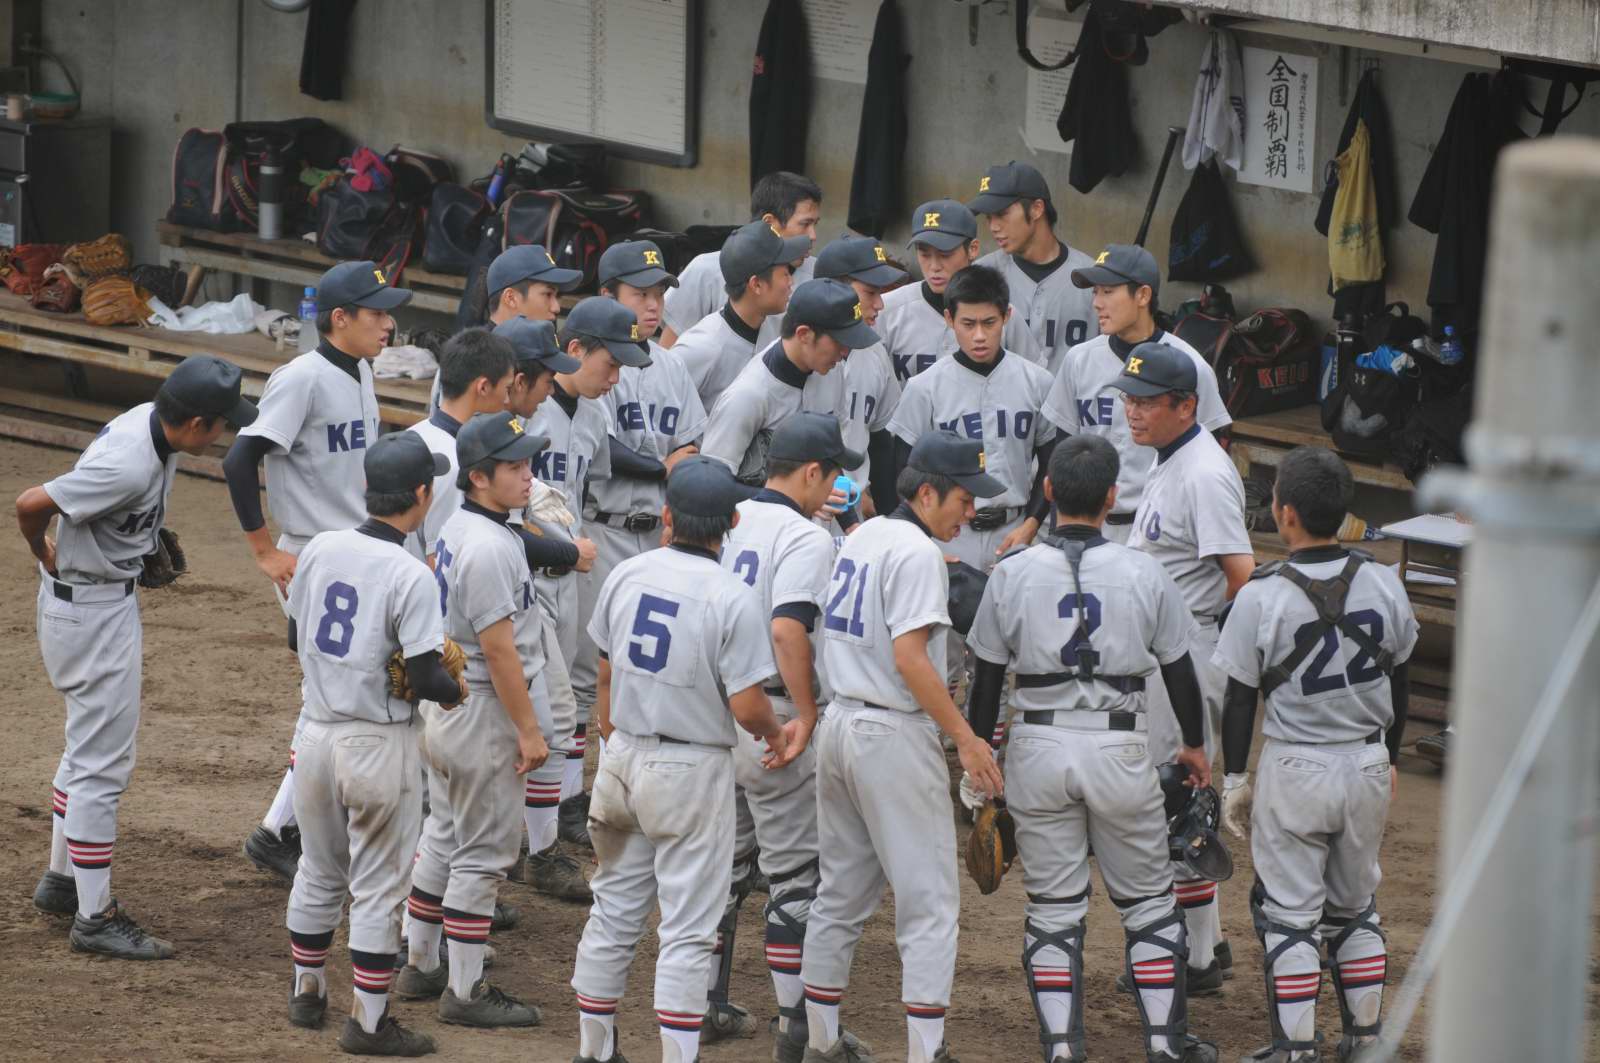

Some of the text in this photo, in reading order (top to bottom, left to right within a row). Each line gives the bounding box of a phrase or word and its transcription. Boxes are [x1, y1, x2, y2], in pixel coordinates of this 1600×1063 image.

[1263, 55, 1298, 178] 全国制覇
[979, 176, 991, 191] K
[923, 212, 940, 227] K
[643, 250, 660, 265] K
[1095, 251, 1110, 264] K
[1045, 318, 1088, 348] IO
[893, 353, 937, 381] KE
[1126, 356, 1144, 374] K
[616, 401, 680, 436] KEIO
[849, 391, 876, 425] IO
[1077, 396, 1114, 427] KE
[327, 418, 376, 452] KE
[508, 417, 524, 434] K
[531, 451, 592, 482] KEI
[116, 504, 159, 534] KE
[824, 557, 869, 638] 21
[315, 581, 359, 658] 8
[628, 592, 680, 674] 5
[1057, 593, 1102, 667] 2
[1294, 608, 1384, 696] 22
